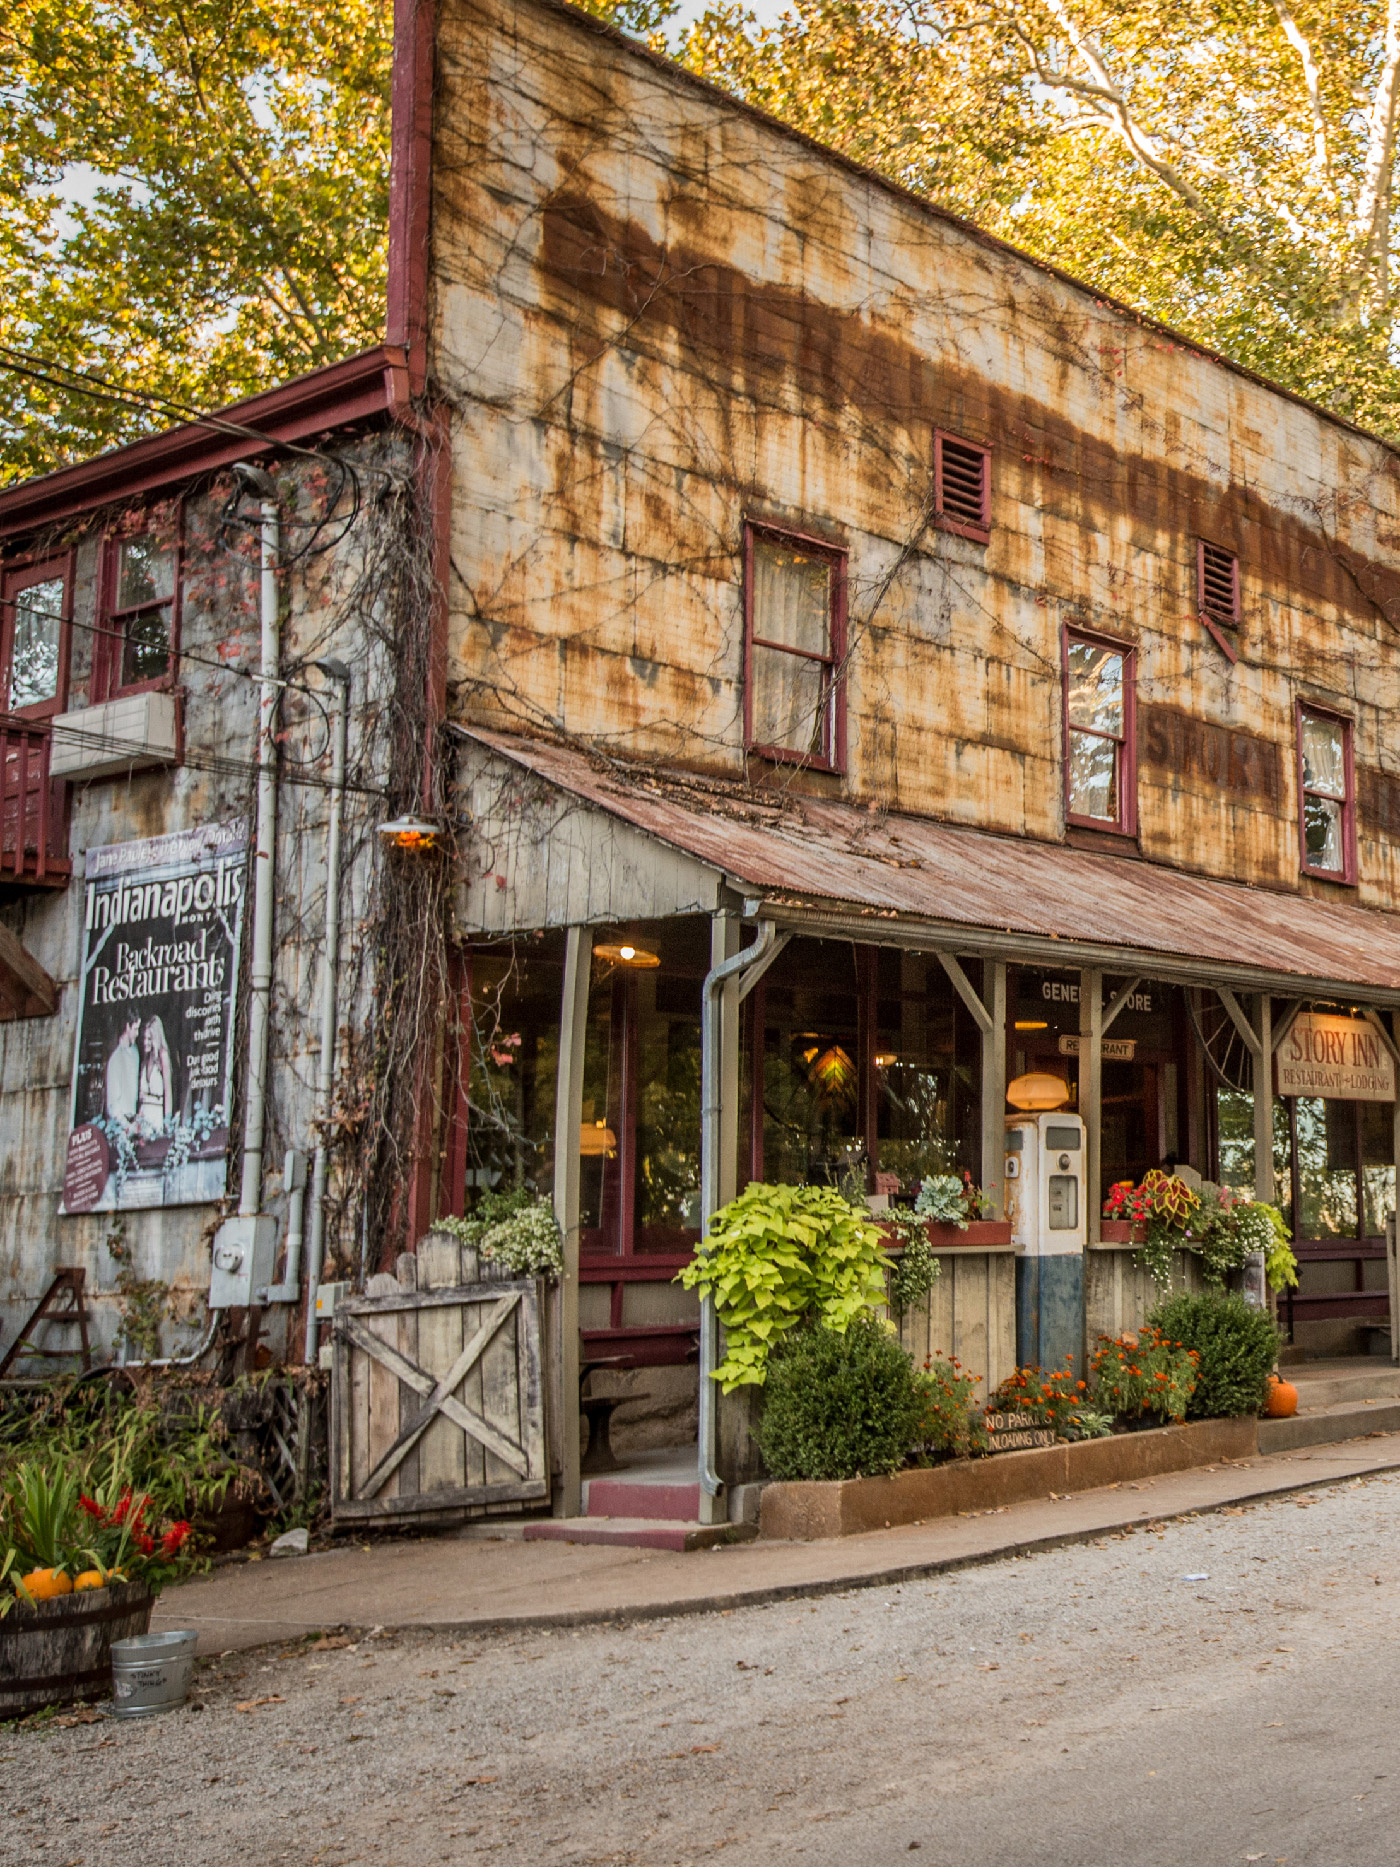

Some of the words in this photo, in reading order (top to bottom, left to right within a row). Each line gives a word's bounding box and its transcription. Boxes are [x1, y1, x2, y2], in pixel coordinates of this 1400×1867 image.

[95, 852, 118, 873] Jane
[85, 857, 243, 930] Indianapolis
[117, 928, 206, 975] Backroad
[91, 952, 225, 1005] Restaurants
[1065, 1039, 1129, 1055] RERANT
[1289, 1027, 1347, 1066] STORY
[1351, 1032, 1380, 1069] INN
[1283, 1068, 1340, 1089] RESTAURANT
[1351, 1074, 1390, 1091] LODGING
[72, 1128, 93, 1147] PLUS
[986, 1414, 1004, 1429] NO
[1034, 1429, 1055, 1448] ONLY
